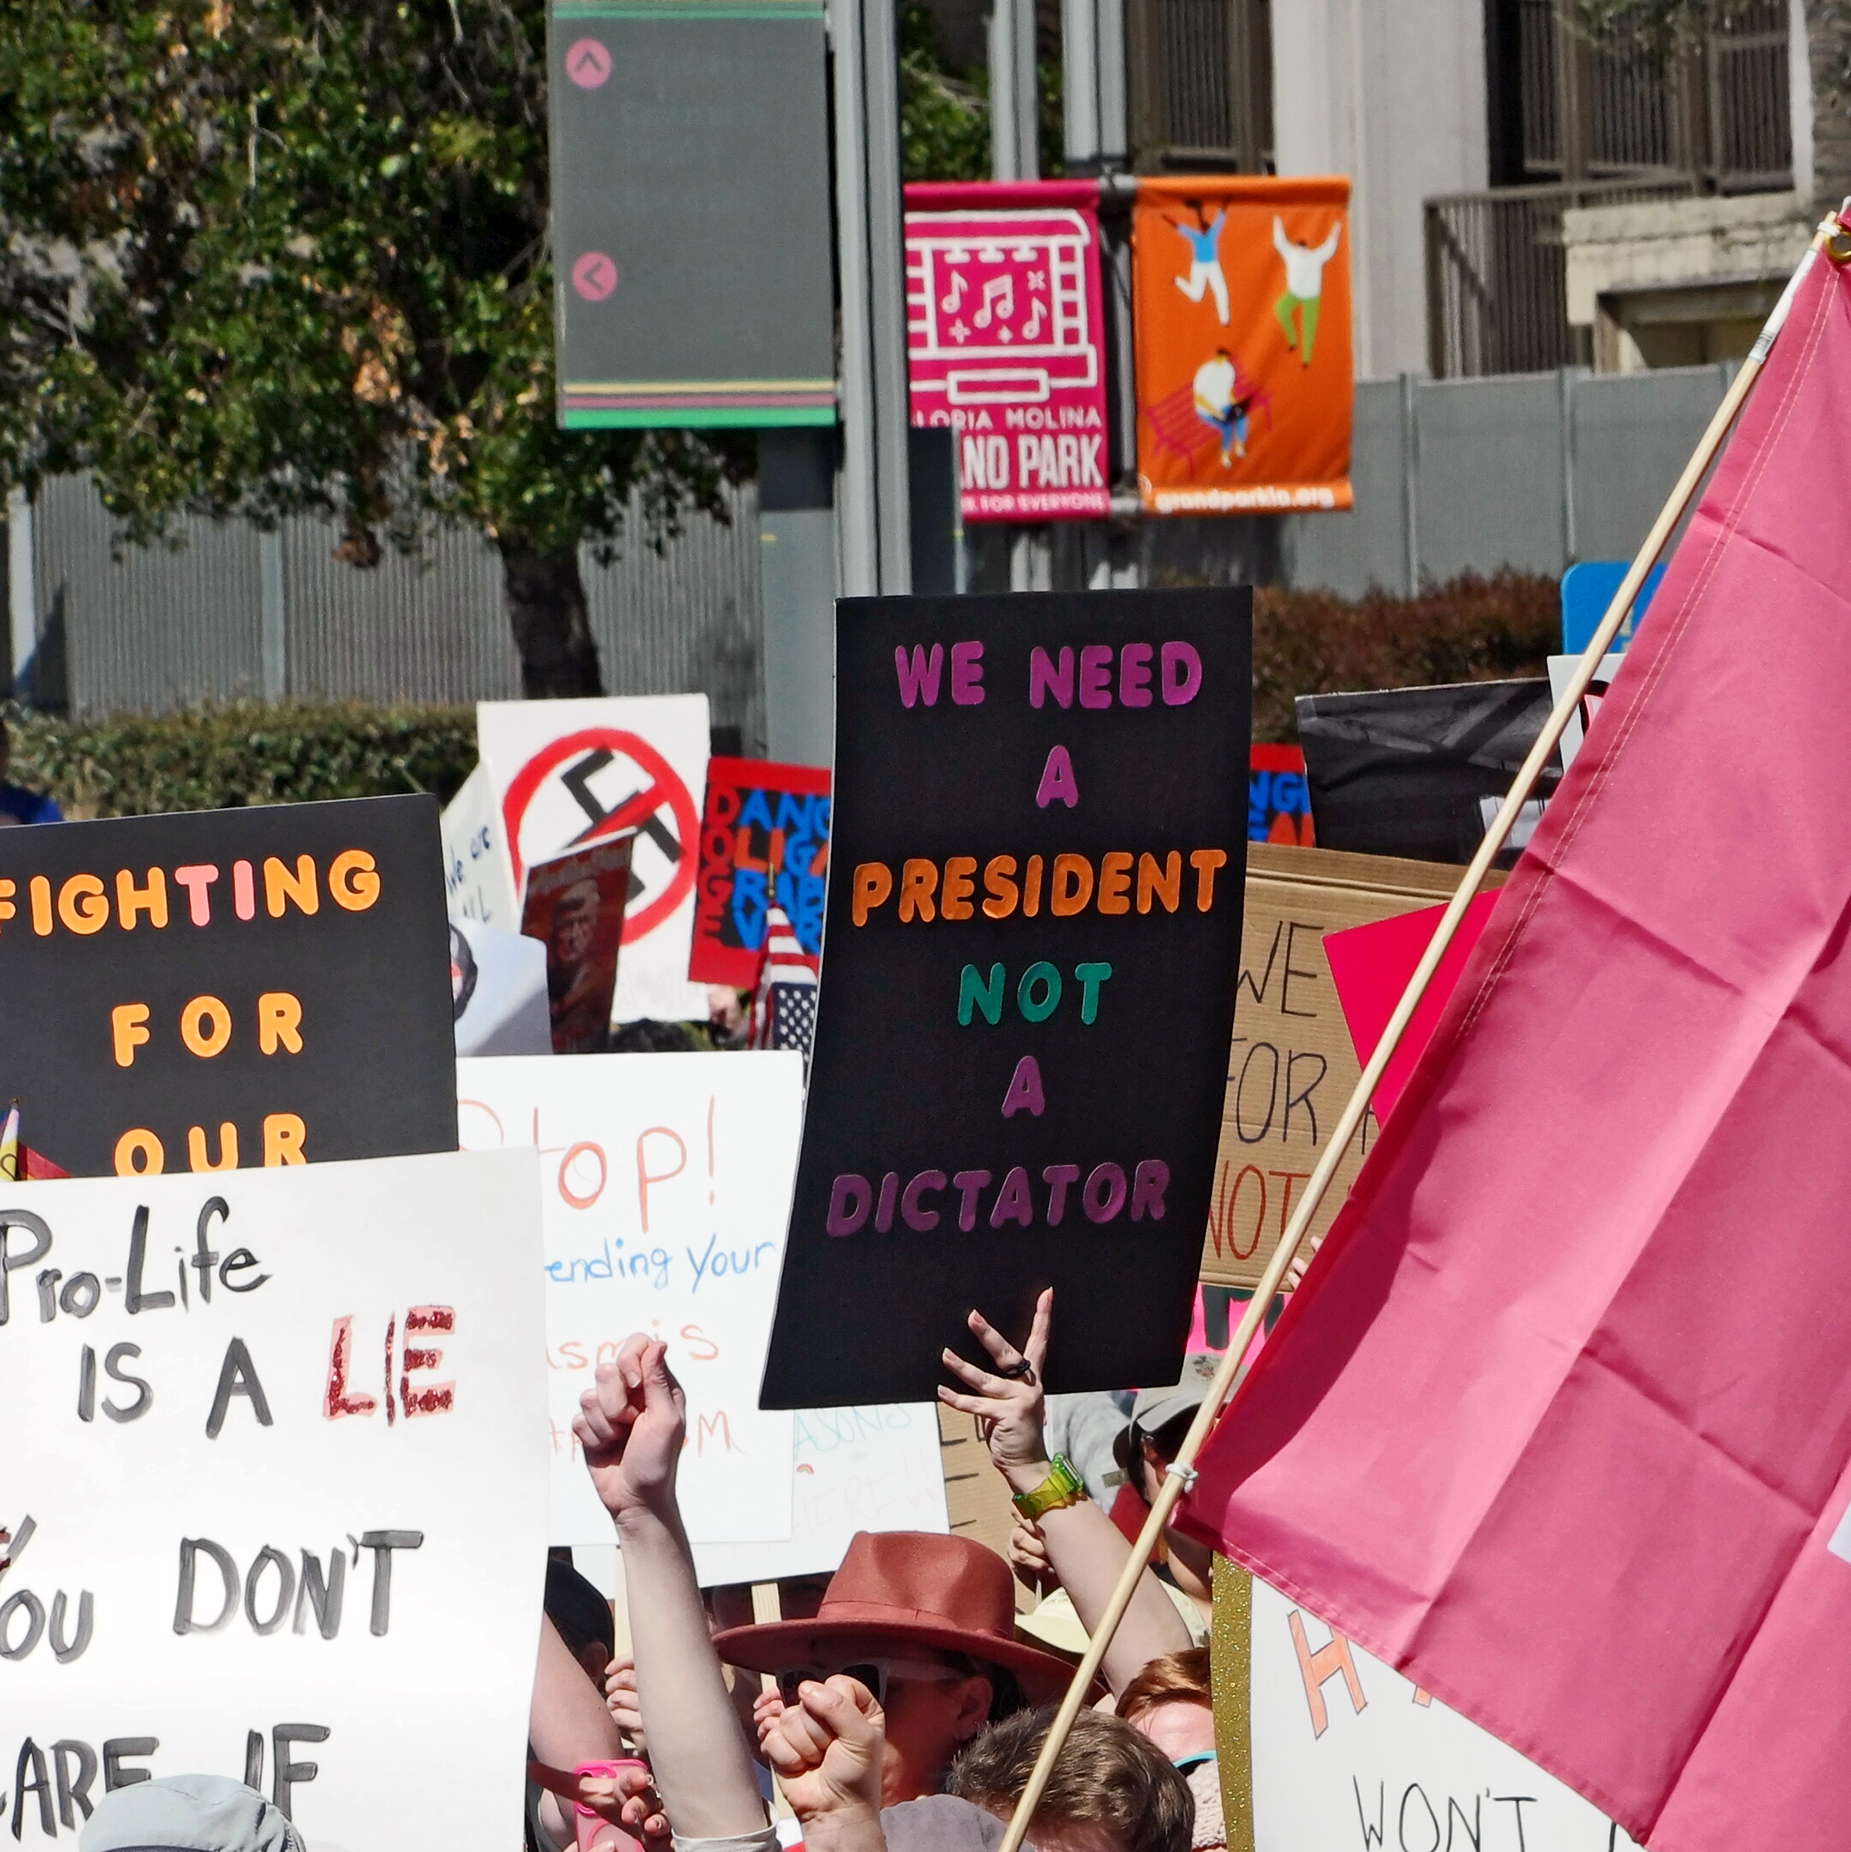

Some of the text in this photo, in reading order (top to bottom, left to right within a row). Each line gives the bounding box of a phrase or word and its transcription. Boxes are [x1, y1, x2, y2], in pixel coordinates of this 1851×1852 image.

[1005, 405, 1101, 431] MOLINA
[1018, 433, 1103, 488] PARK
[895, 639, 1202, 709] WE NEED
[1035, 745, 1079, 811] A
[852, 848, 1227, 927] PRESIDENT
[112, 992, 304, 1067] FOR
[958, 961, 1112, 1027] NOT
[1001, 1054, 1046, 1119] A
[826, 1160, 1170, 1238] DICTATOR
[0, 1197, 271, 1327] Pro-Life
[77, 1304, 458, 1440] IS A LIE
[172, 1529, 424, 1638] DON'T
[243, 1724, 331, 1825] IF
